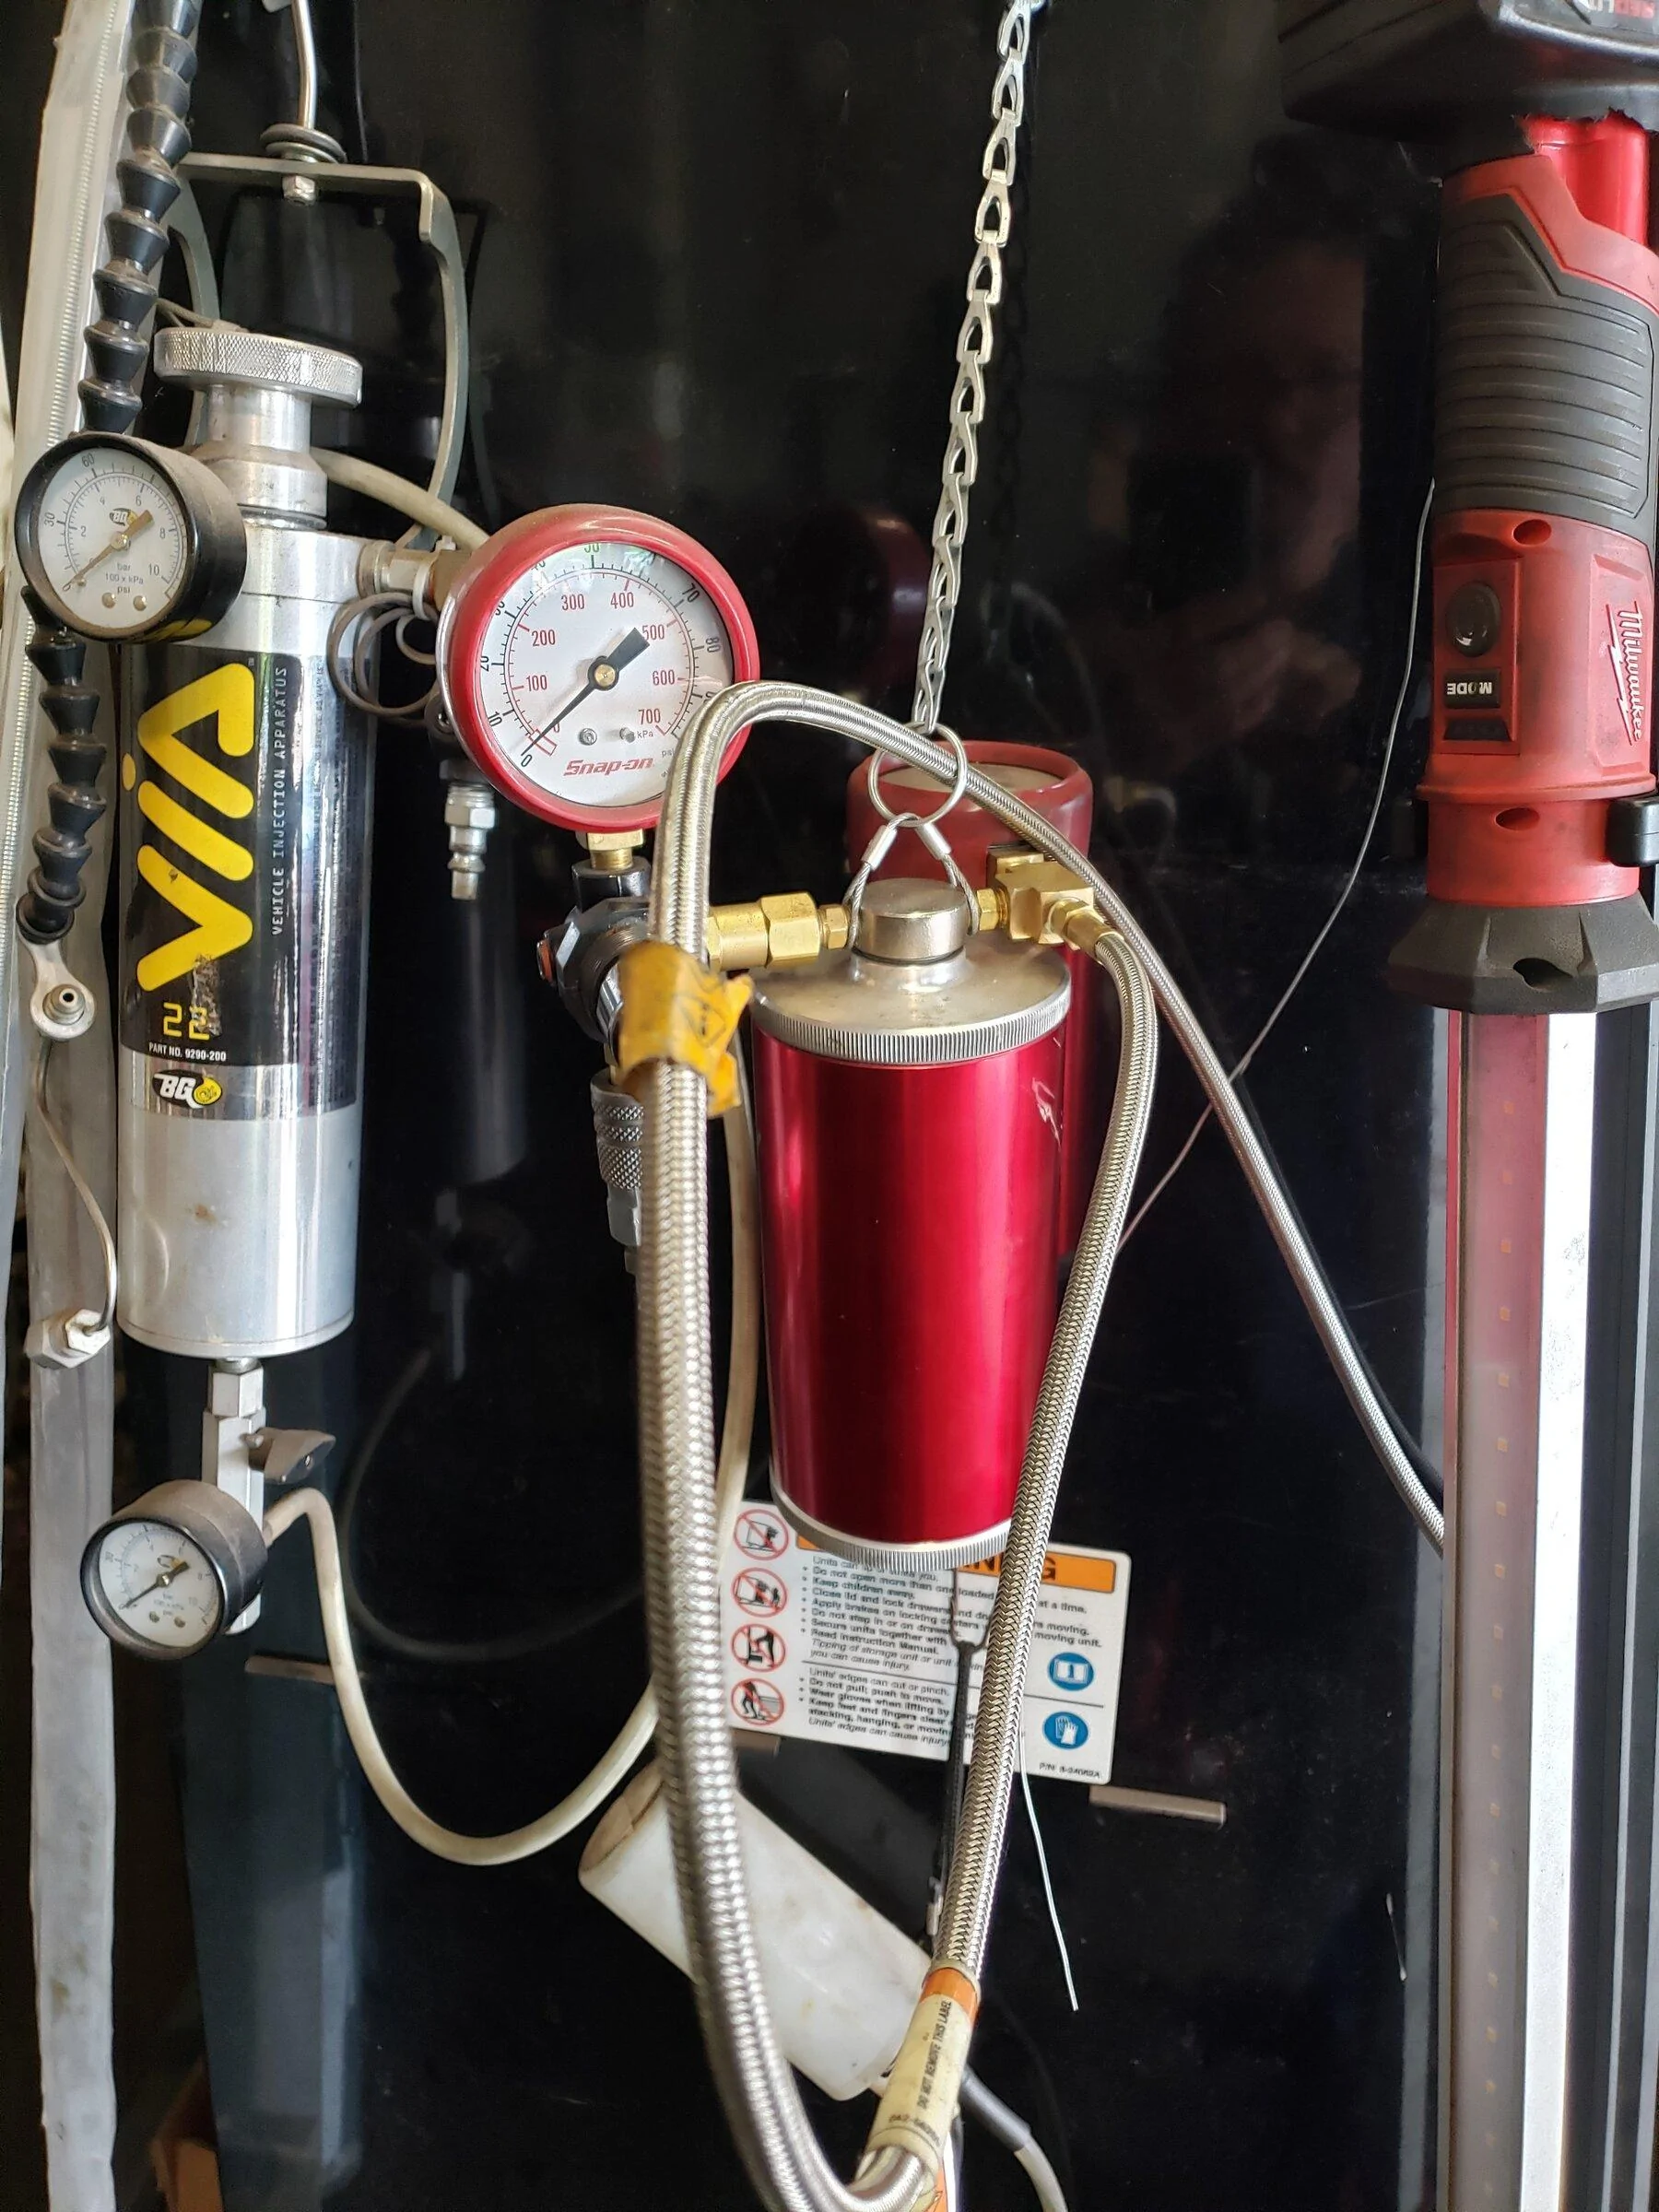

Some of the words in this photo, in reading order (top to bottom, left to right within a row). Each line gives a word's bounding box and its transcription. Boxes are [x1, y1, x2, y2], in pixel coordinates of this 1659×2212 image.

[81, 453, 95, 468] 60
[135, 495, 142, 507] 6
[44, 512, 55, 527] 30
[80, 527, 87, 538] 2
[159, 528, 166, 540] 8
[117, 562, 131, 571] bar
[148, 563, 160, 576] 10
[128, 573, 144, 584] kPa
[117, 585, 131, 594] psi
[682, 582, 700, 603] 70
[560, 594, 586, 612] 300
[610, 592, 635, 610] 400
[531, 630, 557, 647] 200
[642, 624, 665, 641] 500
[705, 637, 721, 653] 80
[653, 669, 676, 686] 600
[1617, 600, 1645, 743] Milwaukee
[526, 675, 547, 691] 100
[1447, 682, 1493, 695] MODE
[275, 667, 288, 760] APPARATUS
[487, 712, 503, 728] 10
[638, 708, 662, 724] 700
[636, 728, 653, 739] kPa
[520, 754, 533, 768] 0
[563, 758, 655, 776] Snap-on
[273, 769, 286, 859] INJECTION
[271, 865, 285, 936] VEHICLE
[149, 1041, 168, 1055] PART
[169, 1045, 182, 1058] NO.
[812, 1576, 839, 1589] Keep
[841, 1581, 884, 1594] children
[812, 1565, 827, 1575] Do
[830, 1569, 847, 1578] not
[850, 1572, 876, 1583] open
[878, 1577, 906, 1587] more
[909, 1580, 932, 1591] than
[957, 1586, 994, 1600] loaded
[1060, 1601, 1088, 1614] time.
[811, 1607, 826, 1617] Do
[829, 1610, 845, 1619] not
[849, 1614, 870, 1625] step
[873, 1617, 883, 1625] in
[886, 1619, 898, 1628] or
[812, 1587, 841, 1598] Close
[843, 1592, 857, 1600] lid
[860, 1594, 879, 1604] and
[882, 1597, 903, 1607] lock
[1045, 1621, 1089, 1636] moving.
[810, 1618, 847, 1630] Secure
[849, 1624, 876, 1634] units
[877, 1628, 923, 1643] together
[924, 1634, 947, 1645] with
[811, 1597, 841, 1611] Apply
[843, 1602, 879, 1615] brakes
[898, 1610, 937, 1624] locking
[1034, 1630, 1076, 1645] moving
[1077, 1636, 1102, 1648] unit.
[810, 1628, 837, 1639] Read
[898, 1641, 939, 1654] Manual.
[809, 1649, 827, 1660] you
[830, 1653, 848, 1661] can
[850, 1655, 880, 1665] cause
[811, 1638, 847, 1652] Tipping
[849, 1643, 859, 1652] of
[861, 1645, 897, 1660] storage
[900, 1652, 918, 1661] unit
[933, 1656, 951, 1666] unit
[808, 1677, 823, 1686] Do
[826, 1680, 842, 1689] not
[871, 1687, 897, 1699] push
[900, 1691, 910, 1700] to
[838, 1672, 868, 1685] edges
[870, 1677, 888, 1686] can
[890, 1680, 905, 1688] cut
[920, 1685, 950, 1697] pinch.
[808, 1688, 834, 1697] Wear
[838, 1692, 871, 1705] gloves
[874, 1698, 901, 1708] when
[903, 1701, 934, 1714] lifting
[935, 1707, 949, 1717] by
[808, 1697, 833, 1708] Keep
[837, 1701, 856, 1712] feet
[859, 1705, 877, 1714] and
[880, 1708, 916, 1722] fingers
[920, 1715, 945, 1724] clear
[807, 1708, 853, 1722] stacking,
[855, 1714, 900, 1729] hanging,
[837, 1722, 866, 1734] edges
[868, 1727, 887, 1735] can
[888, 1730, 918, 1740] cause
[938, 2000, 952, 2024] LABEL
